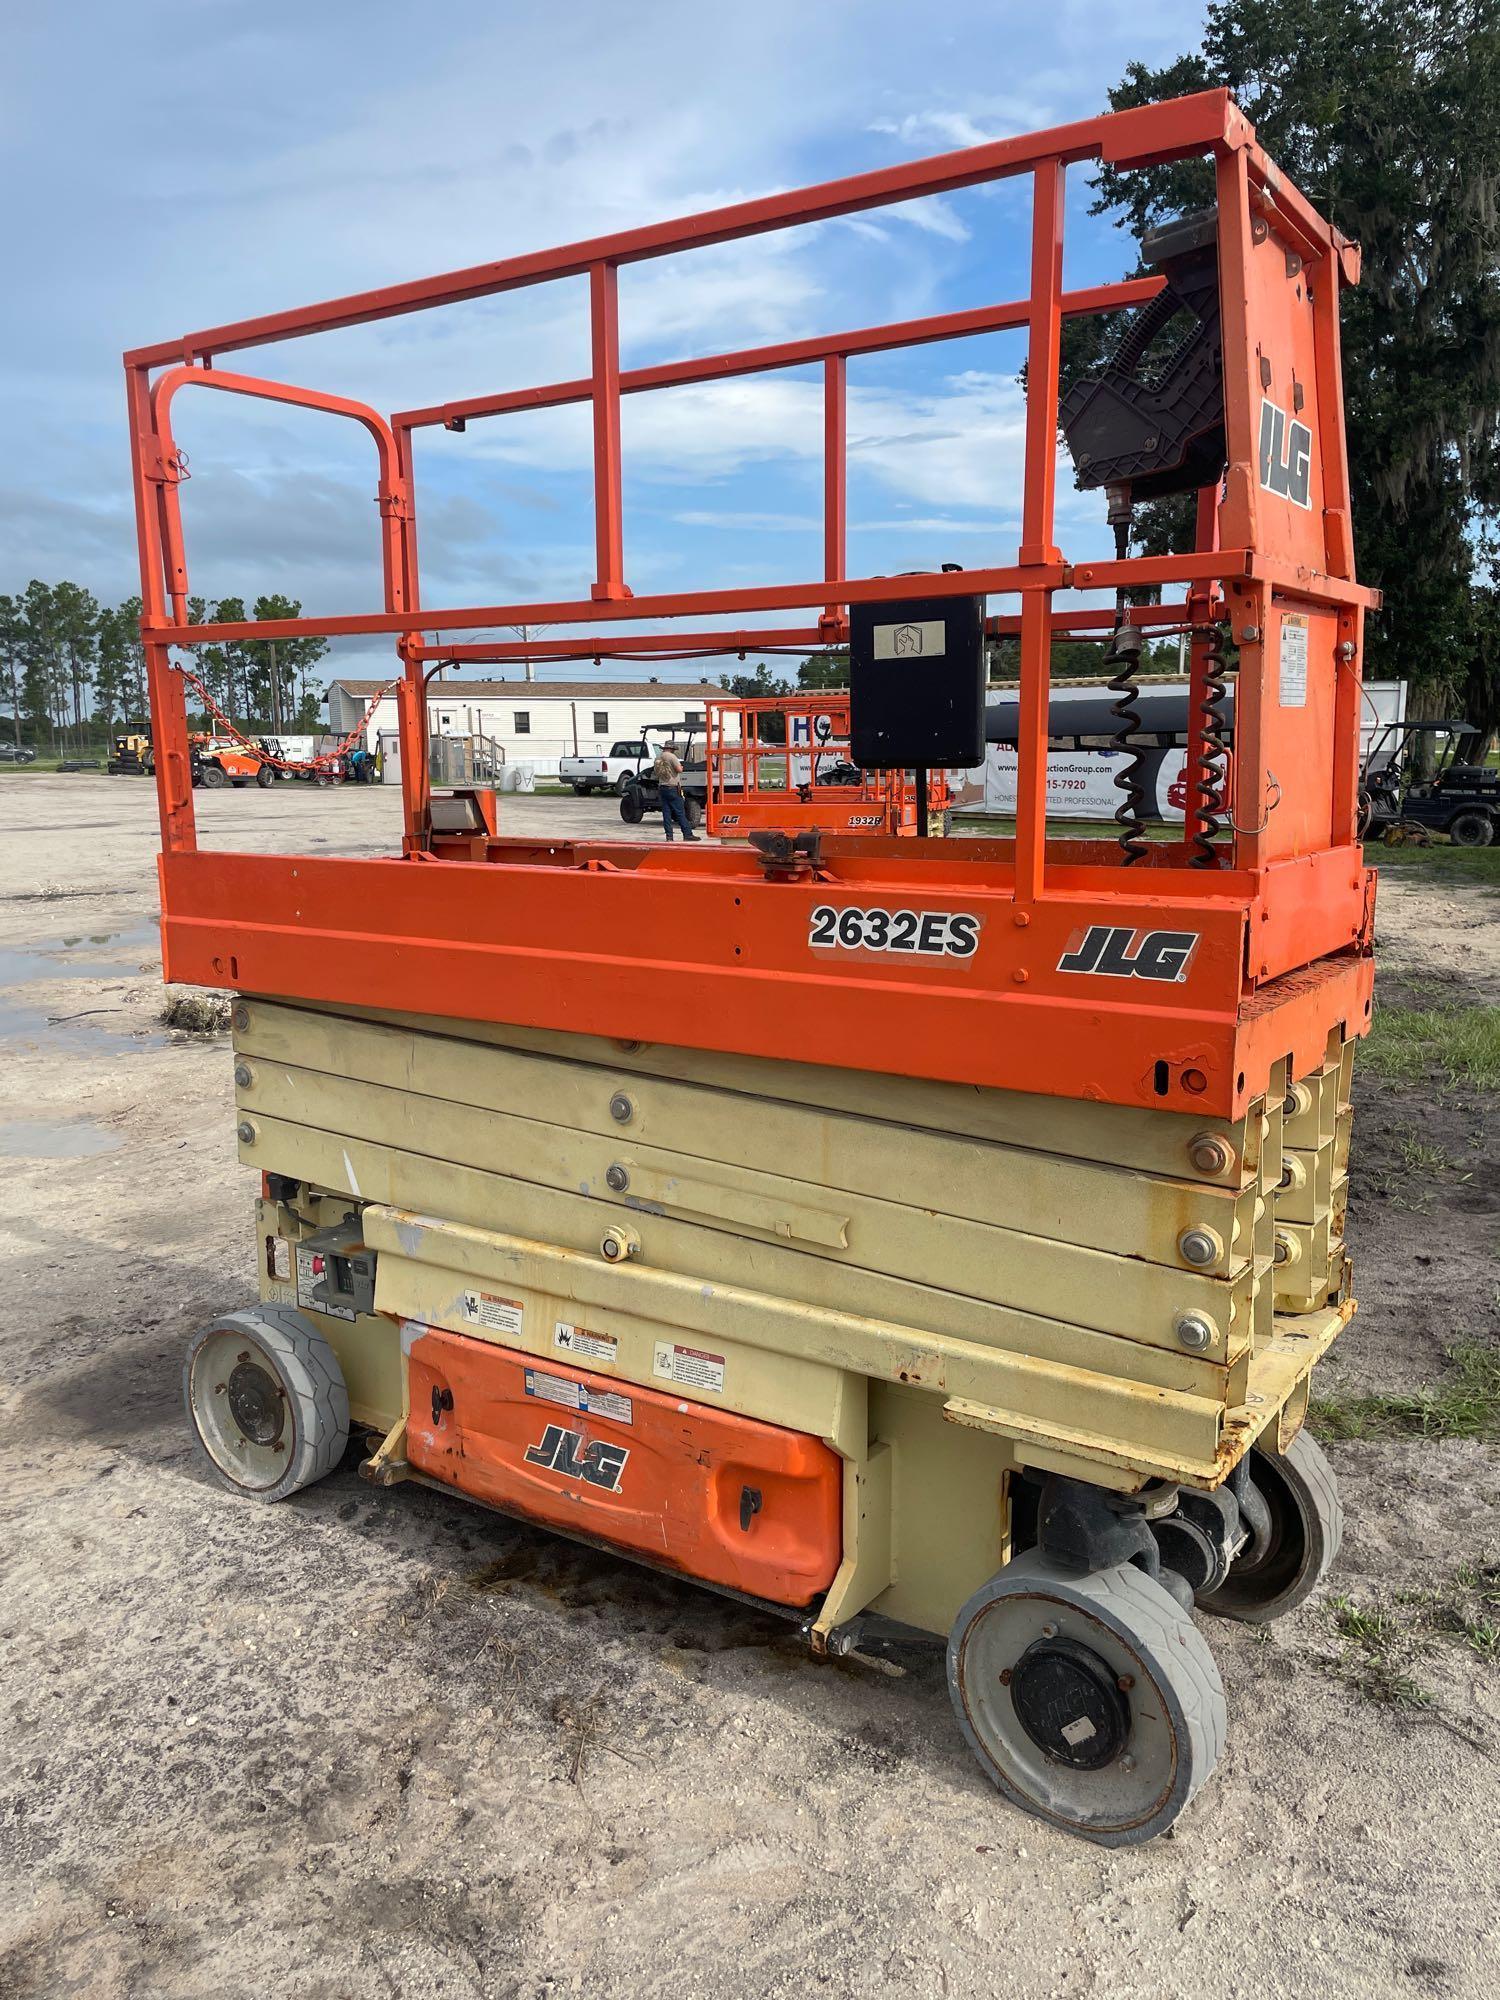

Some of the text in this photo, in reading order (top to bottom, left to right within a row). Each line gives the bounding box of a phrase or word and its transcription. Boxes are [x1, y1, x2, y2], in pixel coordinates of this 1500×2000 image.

[1259, 397, 1312, 511] JLG
[998, 764, 1112, 775] www.uctionGroup.com
[1046, 780, 1086, 790] 15-7920
[718, 815, 740, 824] JLG
[808, 905, 981, 958] 2632ES
[1056, 926, 1200, 982] JLG
[689, 1350, 710, 1360] DANGER
[524, 1424, 630, 1492] JLG
